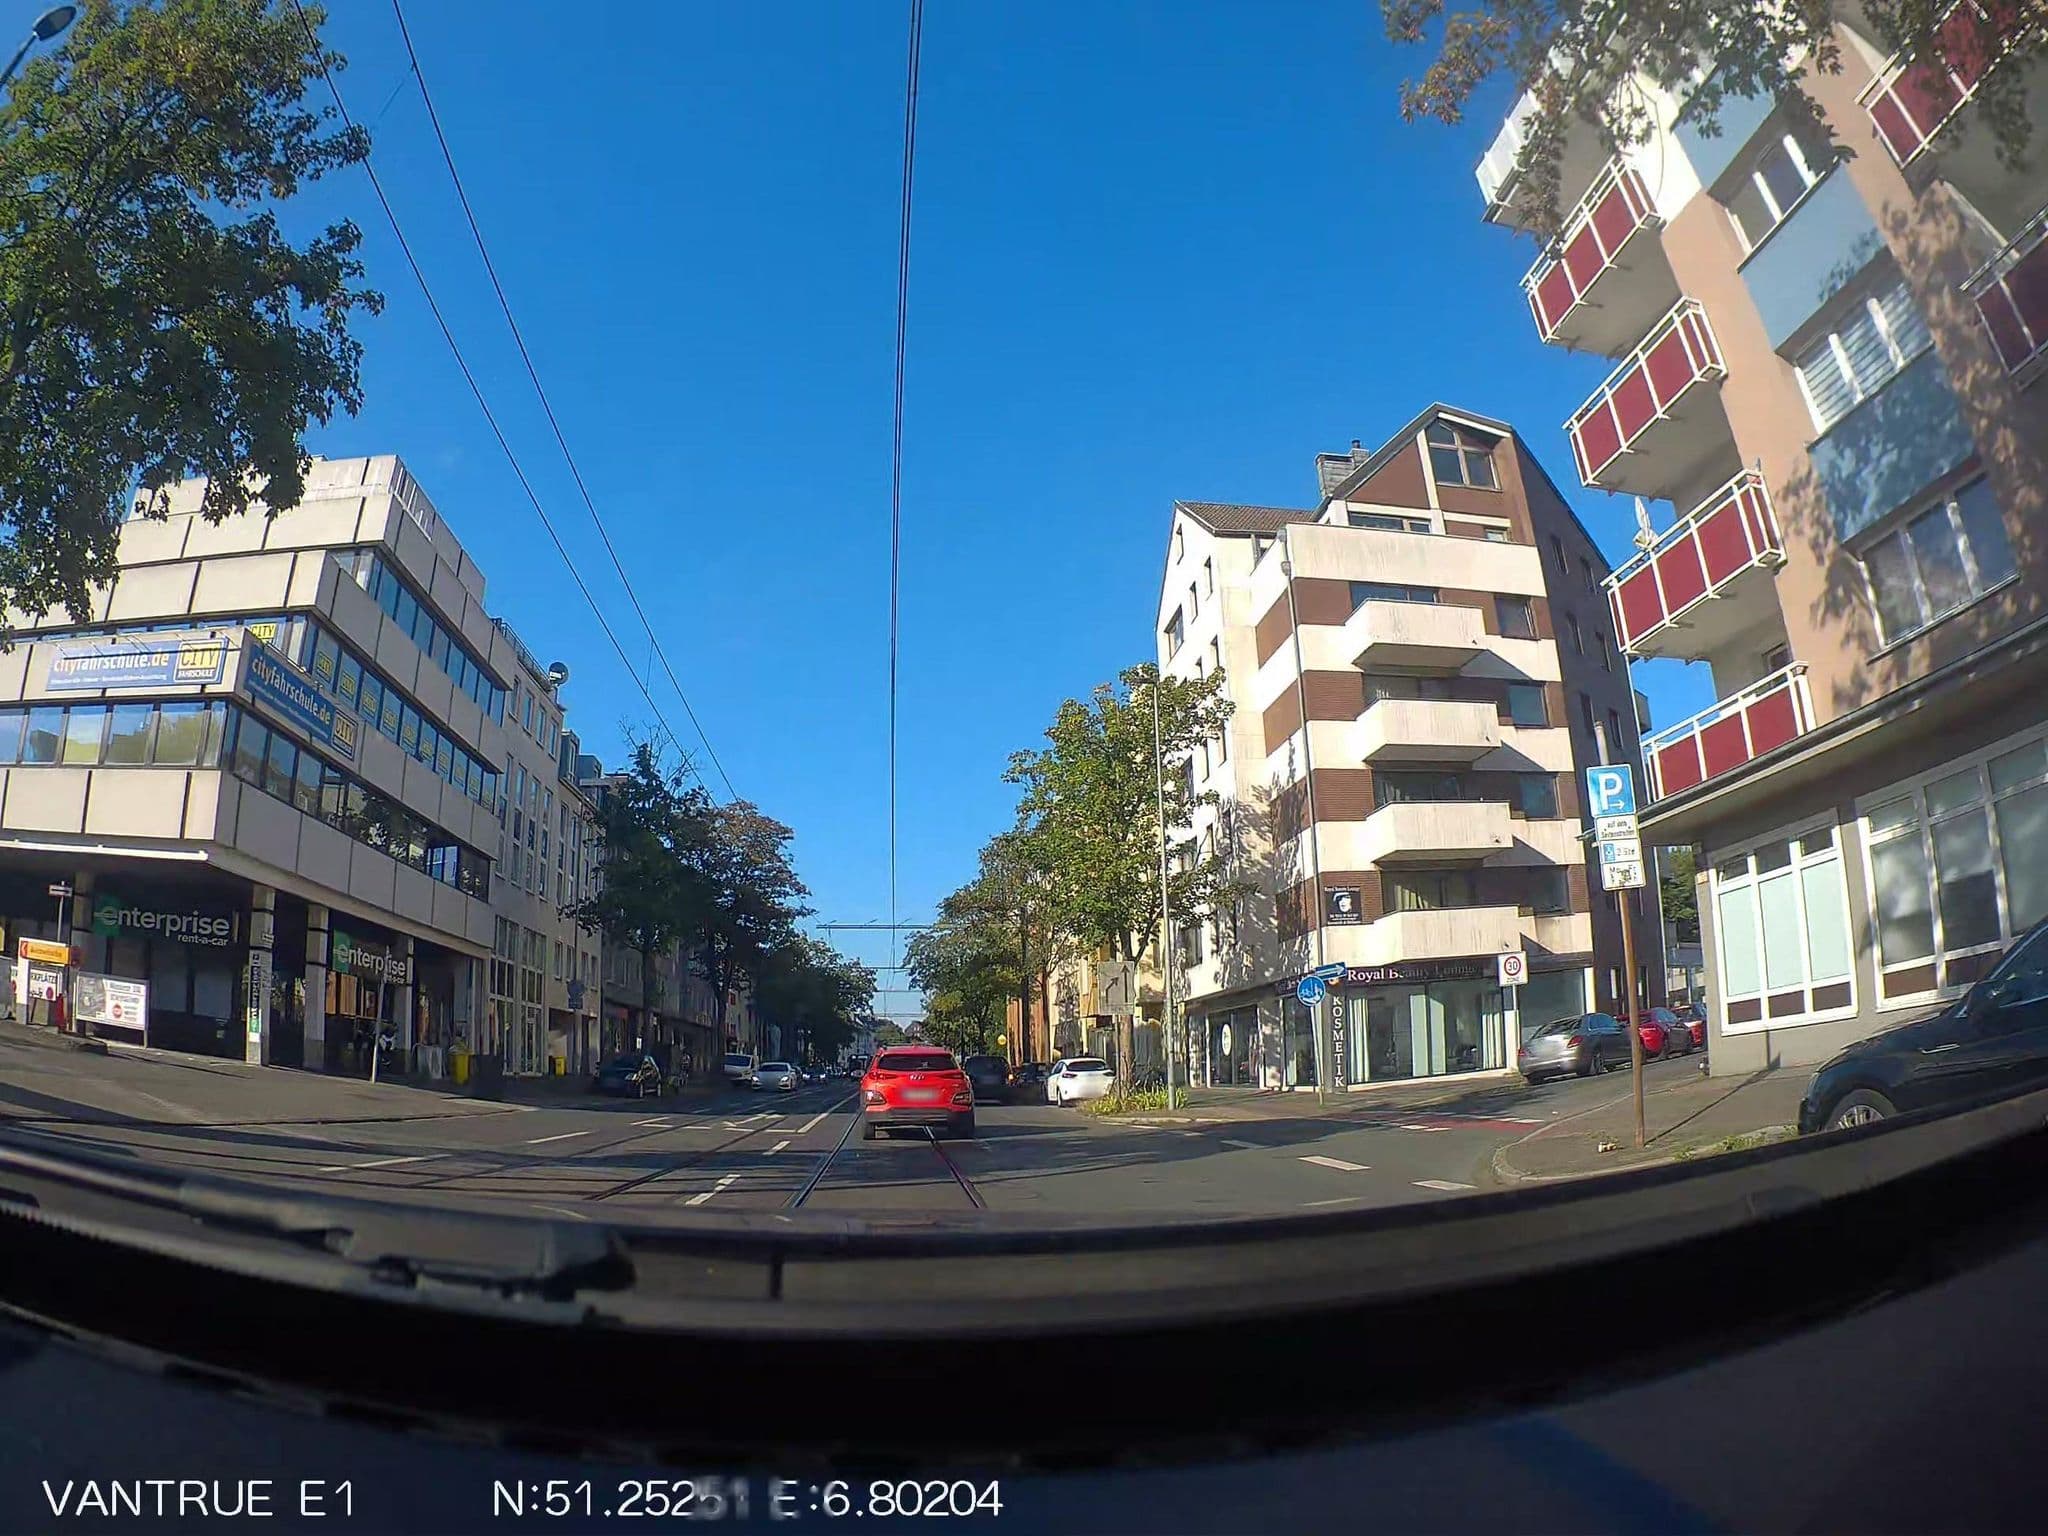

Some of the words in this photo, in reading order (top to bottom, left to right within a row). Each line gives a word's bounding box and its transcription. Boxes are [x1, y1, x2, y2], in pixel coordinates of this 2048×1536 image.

[180, 647, 218, 668] CITY
[251, 655, 331, 726] cityfahrschule.de
[1600, 772, 1623, 811] P
[94, 905, 230, 937] enterprise
[177, 933, 229, 946] rent-a-car
[333, 943, 406, 976] enterprise
[1348, 966, 1385, 983] Royal
[1507, 960, 1518, 971] 30
[1332, 996, 1344, 1087] KOSMETIK
